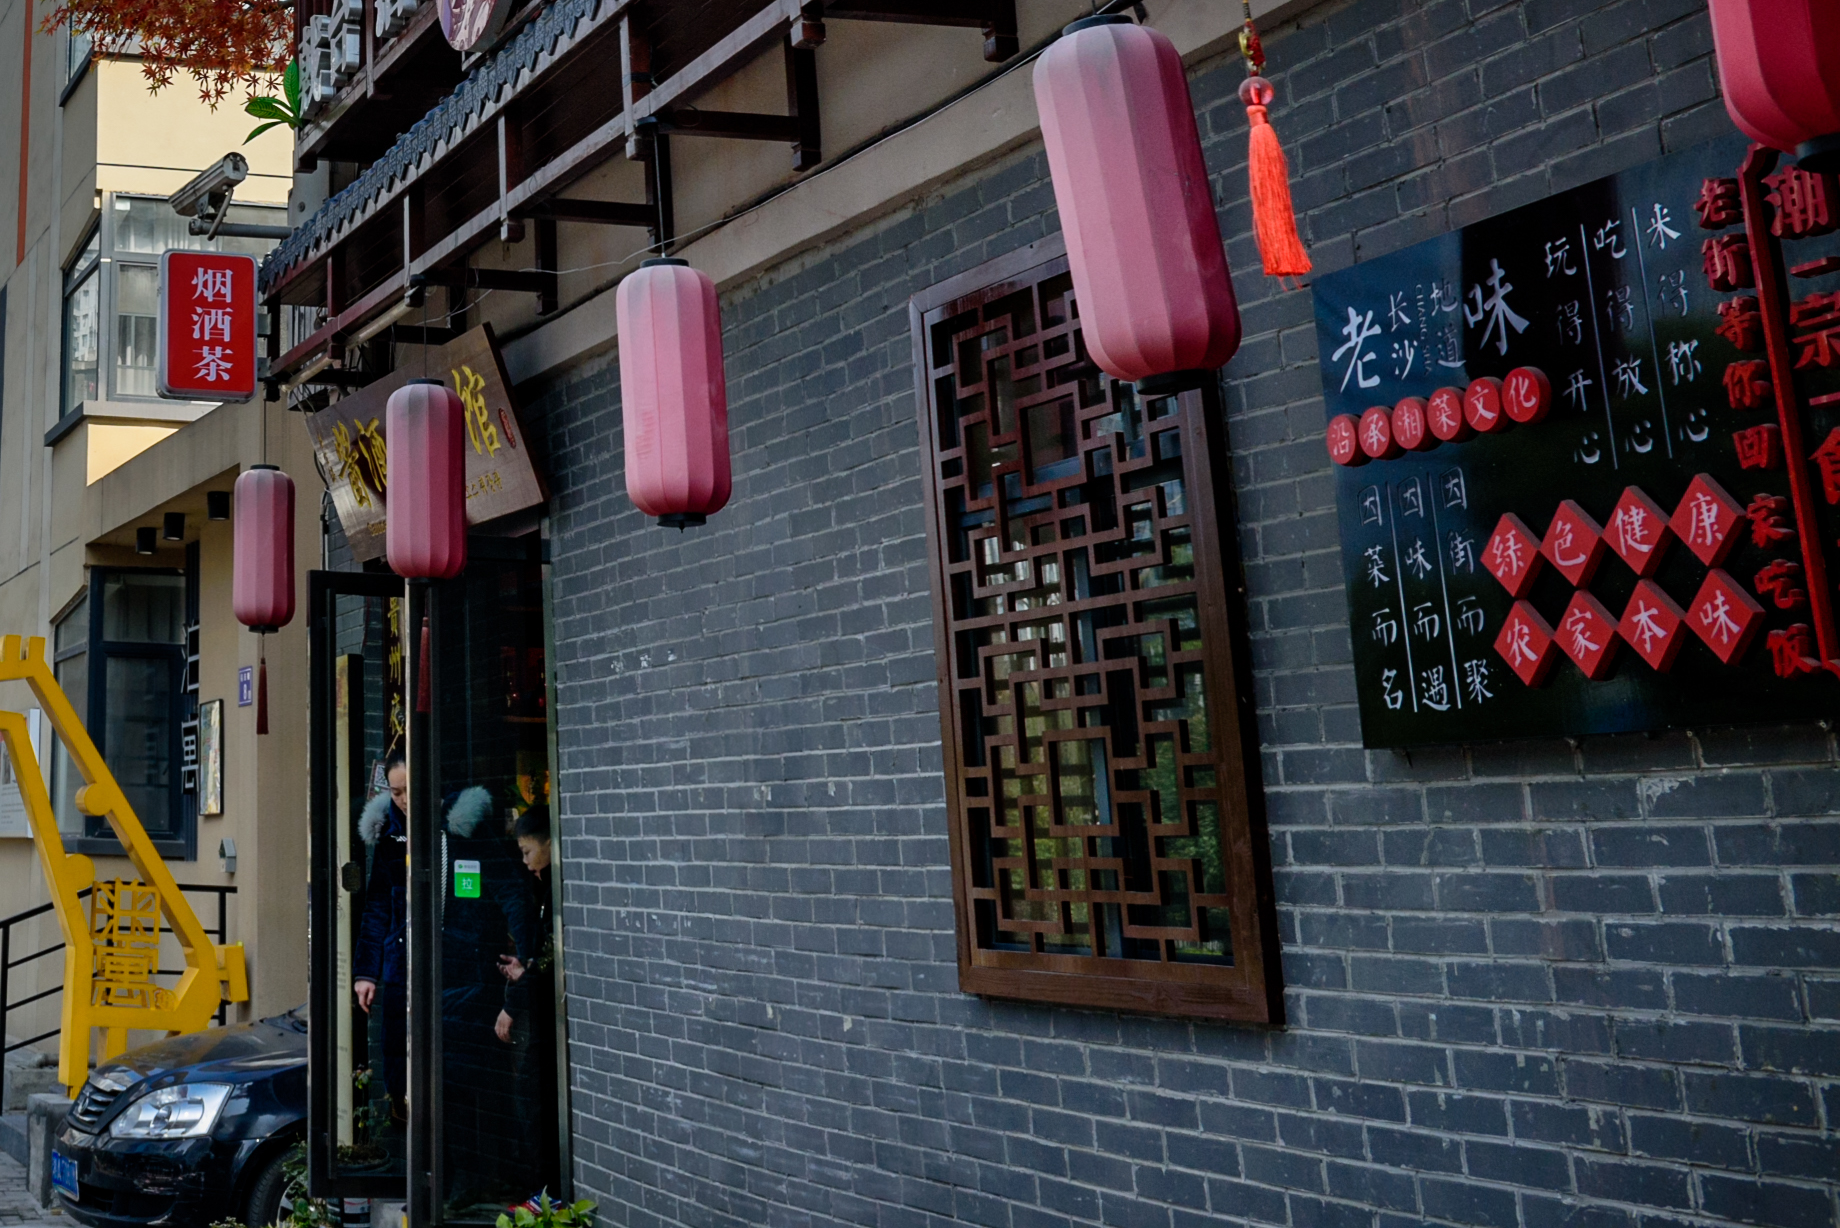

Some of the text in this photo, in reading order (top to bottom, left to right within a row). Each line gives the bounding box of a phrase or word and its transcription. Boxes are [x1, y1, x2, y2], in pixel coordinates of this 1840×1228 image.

[190, 266, 234, 382] 烟酒茶
[1331, 375, 1538, 456] 沿承湘菜文化
[1544, 237, 1601, 464] 玩得开心
[1594, 219, 1653, 453] 吃得放心
[1646, 202, 1709, 442] 来得称心
[1694, 176, 1823, 679] 老街等你回家吃饭
[1357, 485, 1403, 710] 因菜而名
[1439, 466, 1494, 704] 因街而聚
[1492, 492, 1724, 578] 绿色健康
[1505, 589, 1740, 668] 农家本味
